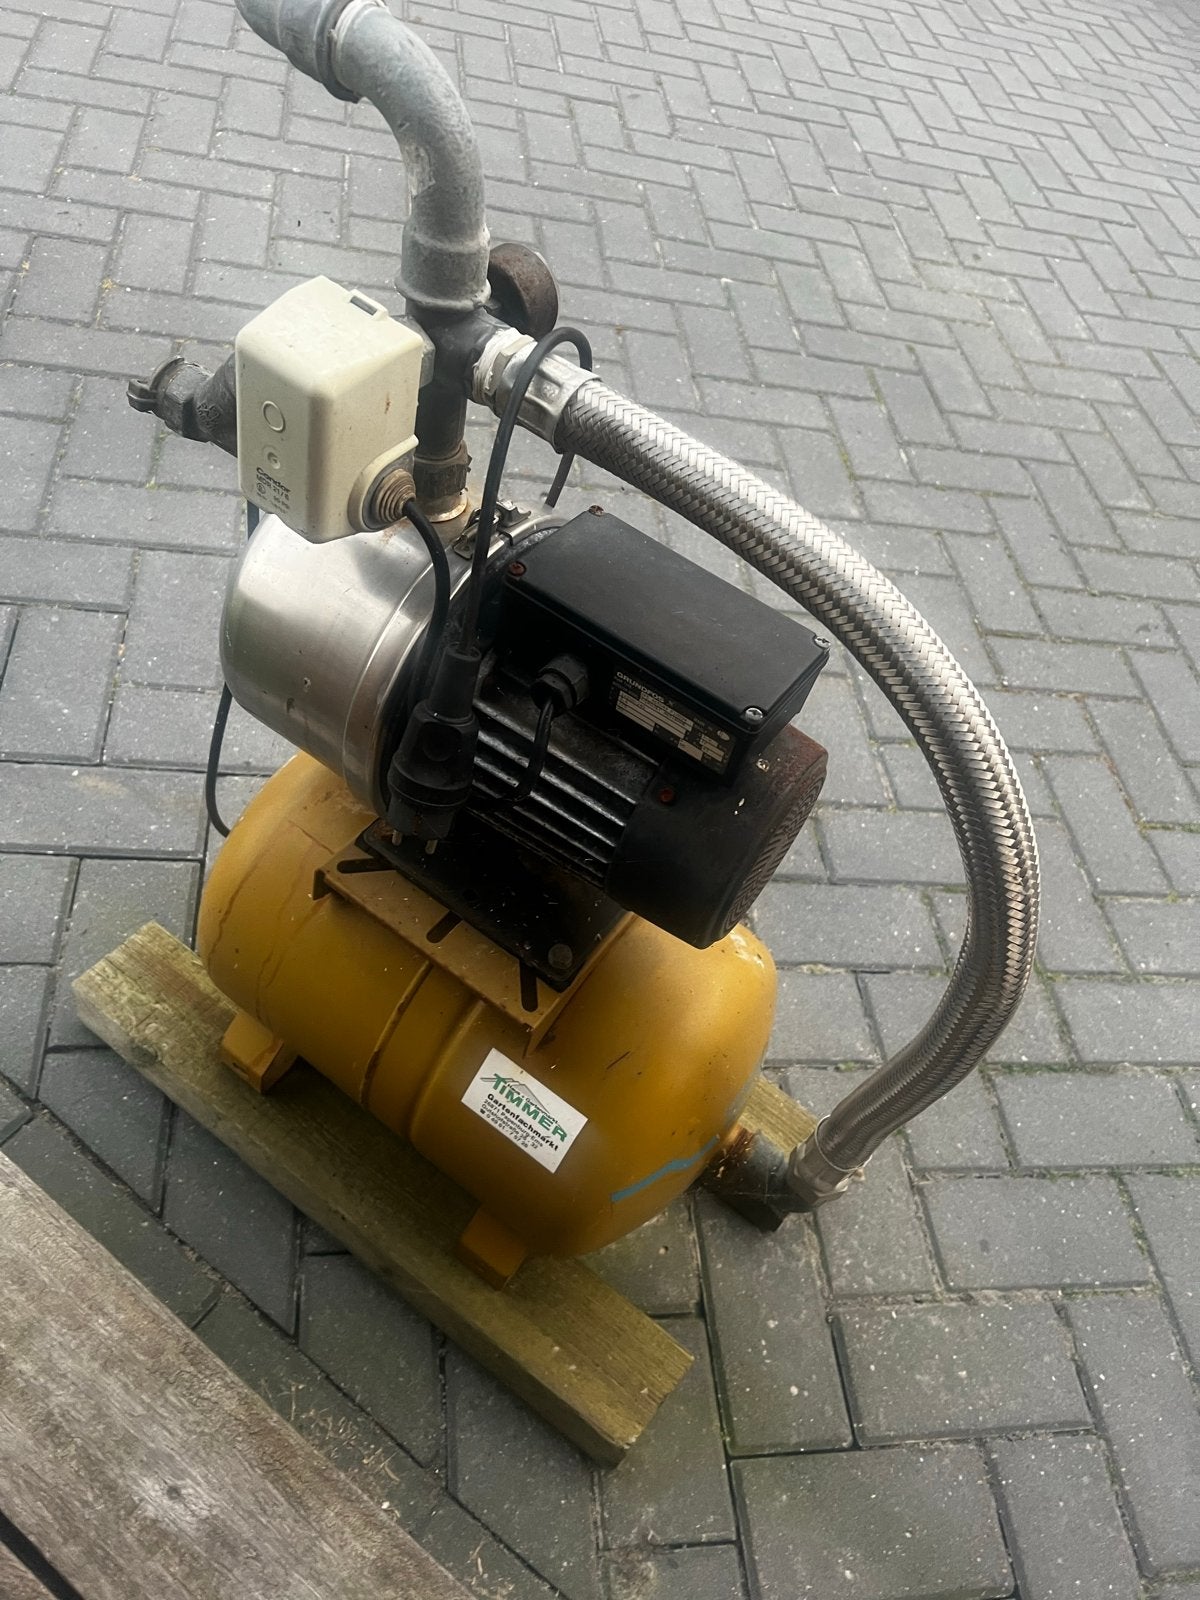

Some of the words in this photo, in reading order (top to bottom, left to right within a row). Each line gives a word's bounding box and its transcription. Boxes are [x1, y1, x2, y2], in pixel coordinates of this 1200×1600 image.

[256, 467, 291, 492] Condor
[616, 671, 664, 703] GRUNDFOS
[487, 1093, 559, 1151] Gartenfachmarkt
